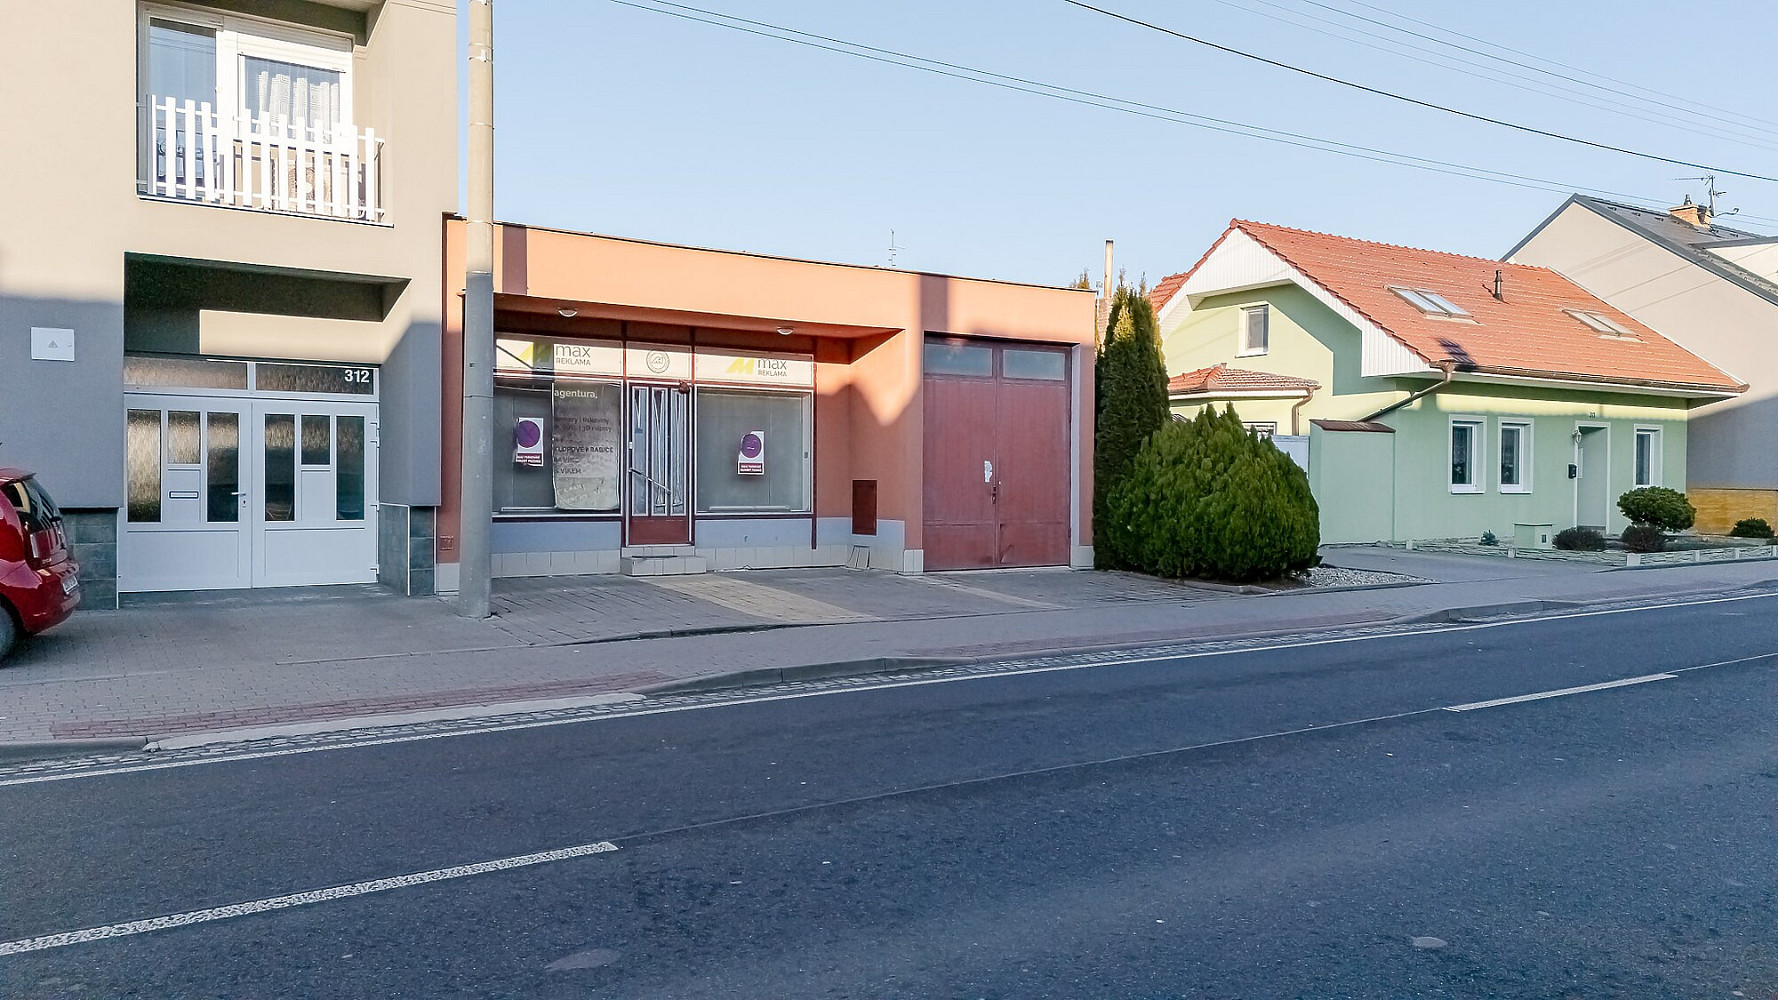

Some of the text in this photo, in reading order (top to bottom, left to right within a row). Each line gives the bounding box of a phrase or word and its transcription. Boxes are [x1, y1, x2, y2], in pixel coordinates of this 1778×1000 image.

[555, 345, 591, 358] max
[556, 358, 591, 366] REKLAMA
[757, 359, 787, 370] max
[344, 369, 370, 383] 312
